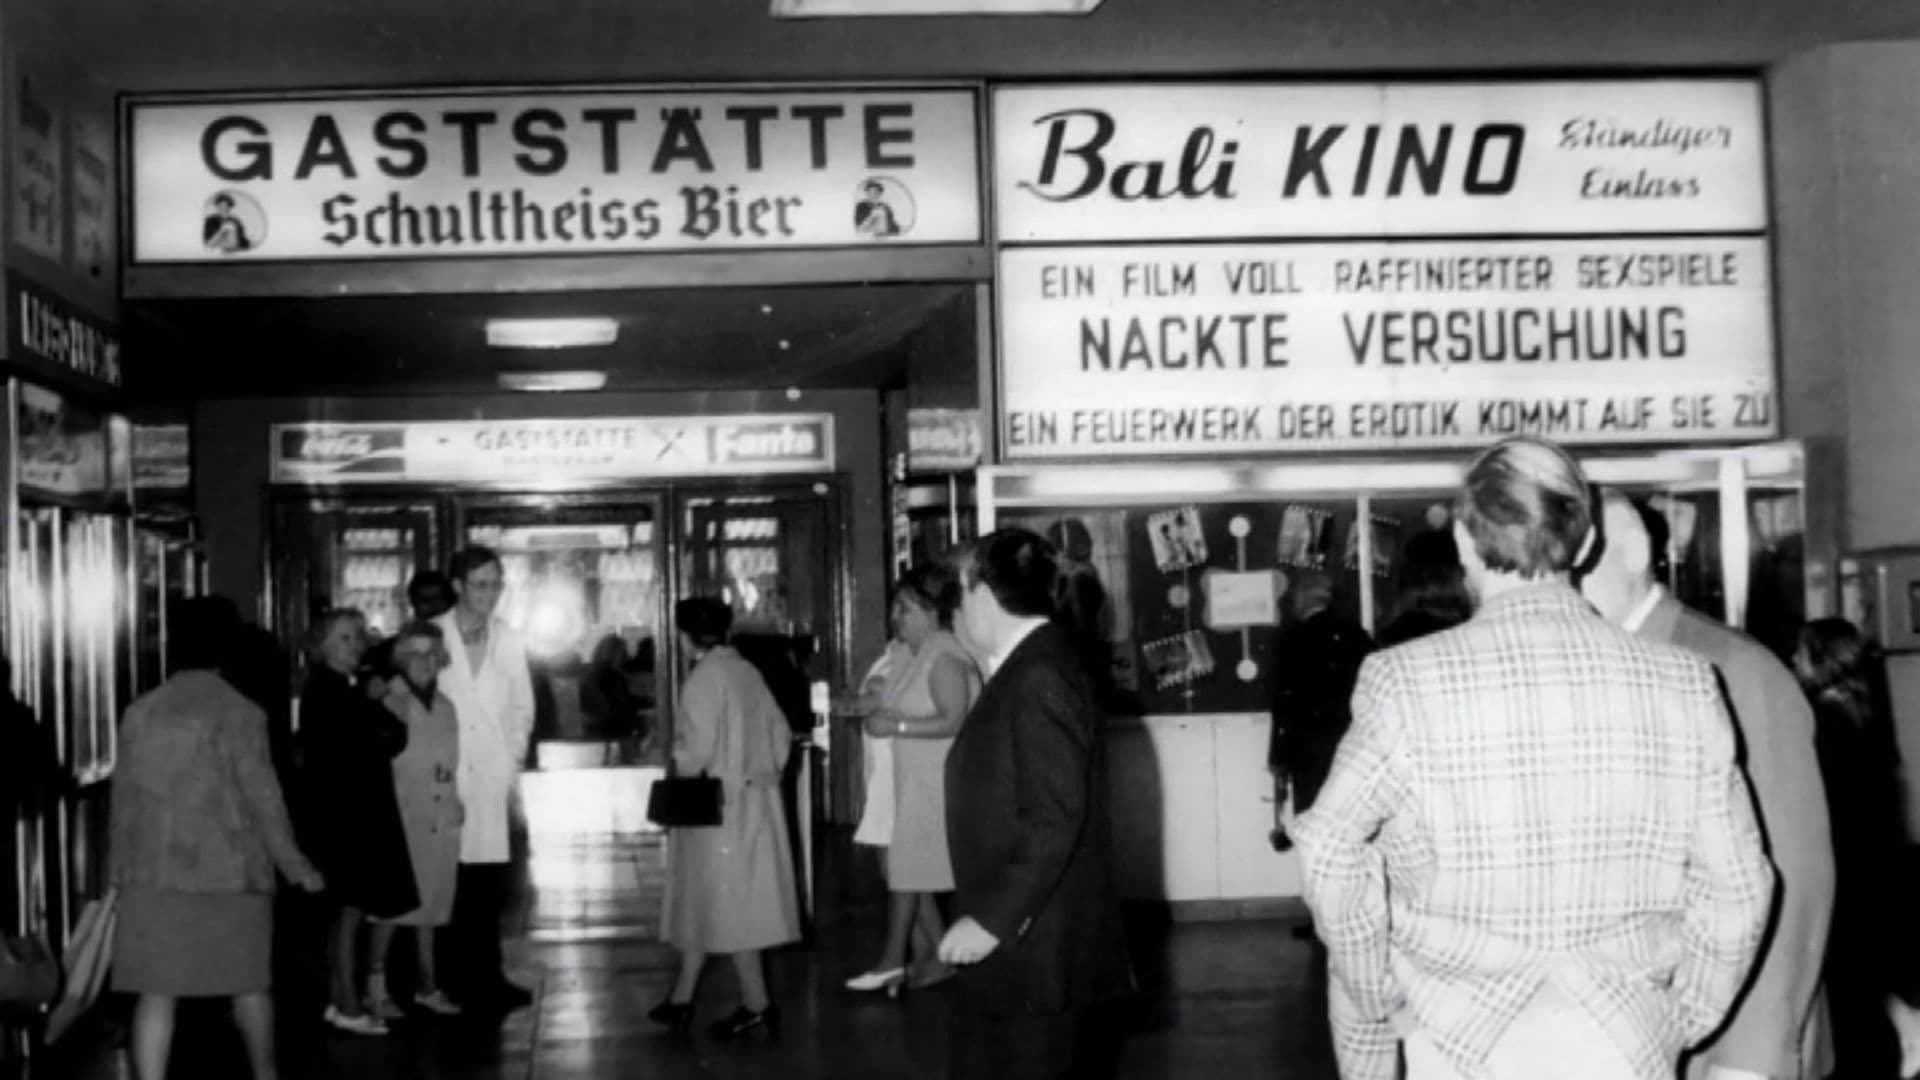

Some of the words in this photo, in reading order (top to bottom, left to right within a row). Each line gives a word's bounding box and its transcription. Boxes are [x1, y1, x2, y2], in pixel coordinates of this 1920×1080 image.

[201, 103, 915, 182] GASTSTÄTTE
[1016, 108, 1239, 202] Bali
[1281, 122, 1526, 198] KINO
[321, 186, 661, 247] Schultheiss
[678, 183, 803, 239] Bier
[1579, 166, 1702, 200] Einlass
[1040, 264, 1096, 299] EIN
[1122, 262, 1197, 297] FILM
[1224, 261, 1303, 295] VOLL
[1334, 256, 1552, 293] RAFFINIERTER
[1577, 252, 1738, 289] SEXSPIELE
[1079, 313, 1290, 372] NACKTE
[1343, 305, 1687, 366] VERSUCHUNG
[1008, 410, 1058, 446] EIN
[1071, 405, 1262, 444] FEUERWERK
[1278, 404, 1336, 440] DER
[1350, 399, 1460, 438] EROTIK
[1477, 399, 1587, 436] KOMMT
[1599, 397, 1656, 430] AUF
[1671, 395, 1716, 429] SIE
[1733, 393, 1771, 429] ZU
